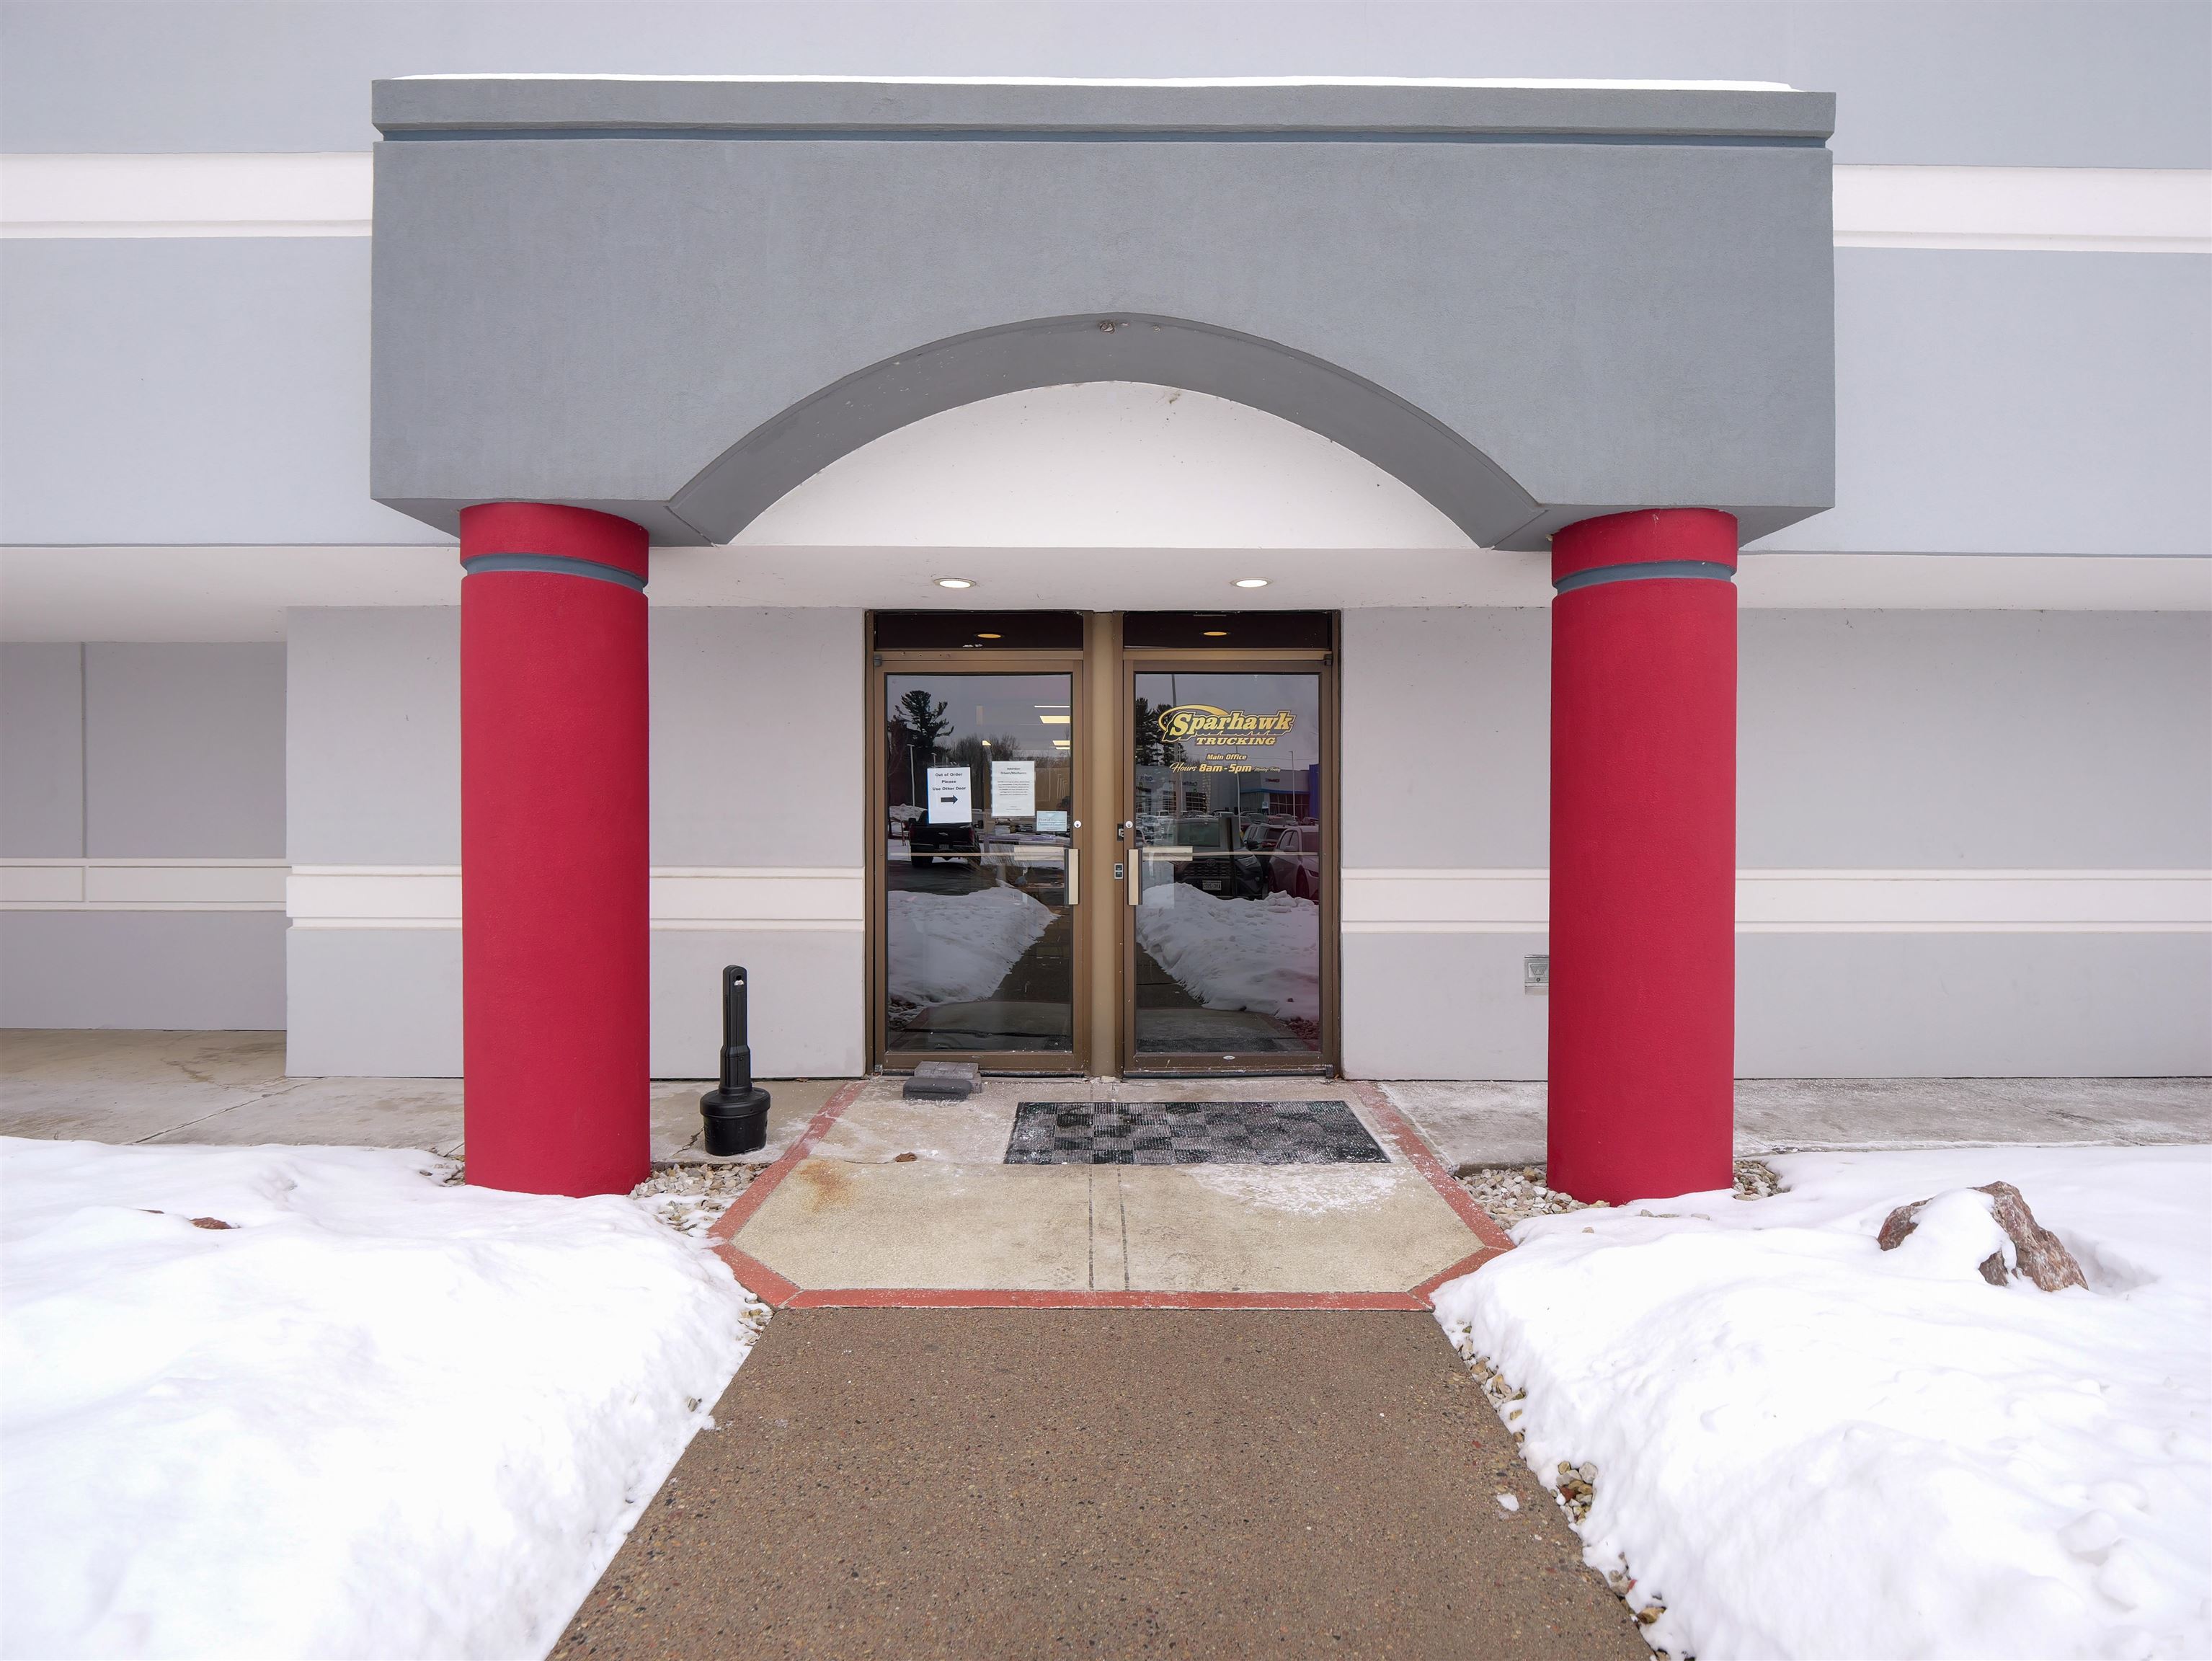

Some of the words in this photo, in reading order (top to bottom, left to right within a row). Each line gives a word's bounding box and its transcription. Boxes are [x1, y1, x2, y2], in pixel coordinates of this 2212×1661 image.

[1167, 711, 1295, 737] Sparhawk
[1196, 737, 1276, 745] TRUCKING
[1169, 762, 1197, 773] Hours
